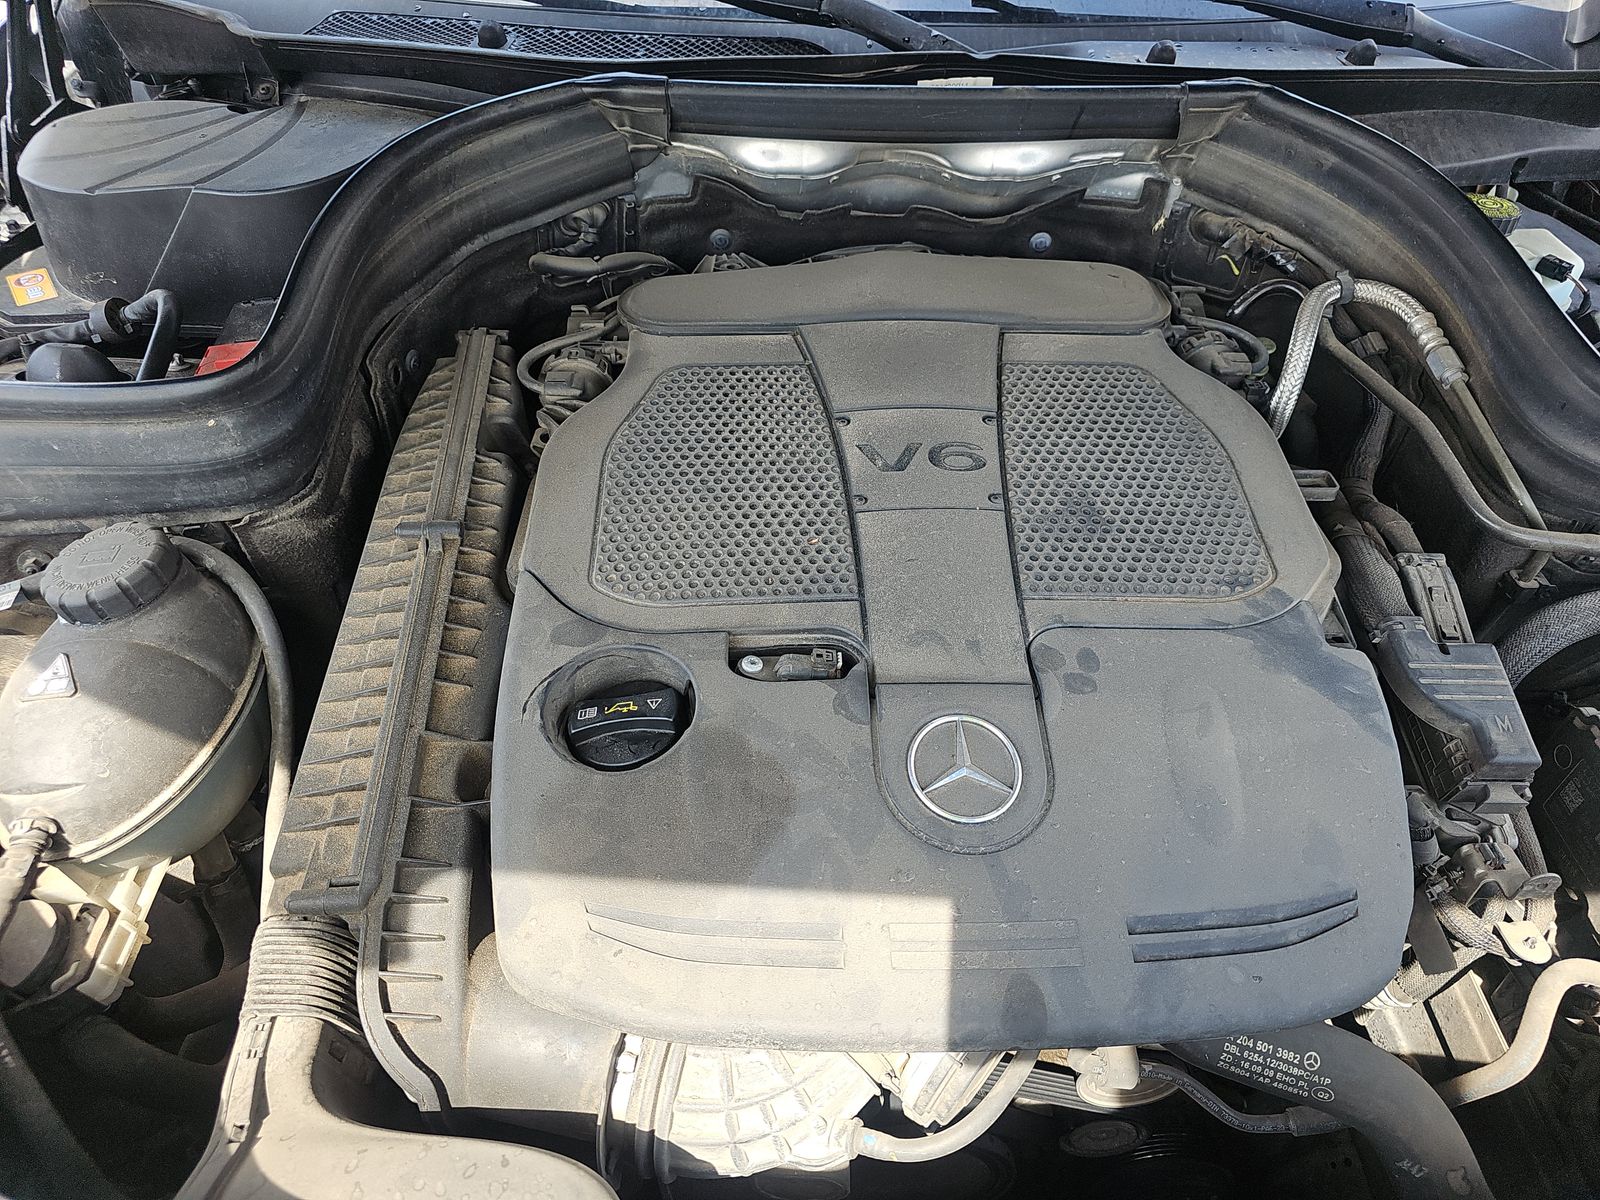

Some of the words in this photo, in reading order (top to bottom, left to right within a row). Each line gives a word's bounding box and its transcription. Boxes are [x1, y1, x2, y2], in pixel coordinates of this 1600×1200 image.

[855, 441, 987, 472] V6
[86, 573, 115, 589] WENN
[1494, 714, 1515, 734] M
[1223, 1042, 1241, 1057] DBL
[1255, 1040, 1274, 1055] 501
[1276, 1047, 1301, 1065] 3982
[1216, 1060, 1250, 1078] ZGS004
[1240, 1060, 1275, 1078] 16.09.09
[1275, 1072, 1296, 1086] EHO
[1297, 1080, 1310, 1091] PL
[1316, 1090, 1330, 1100] Q2
